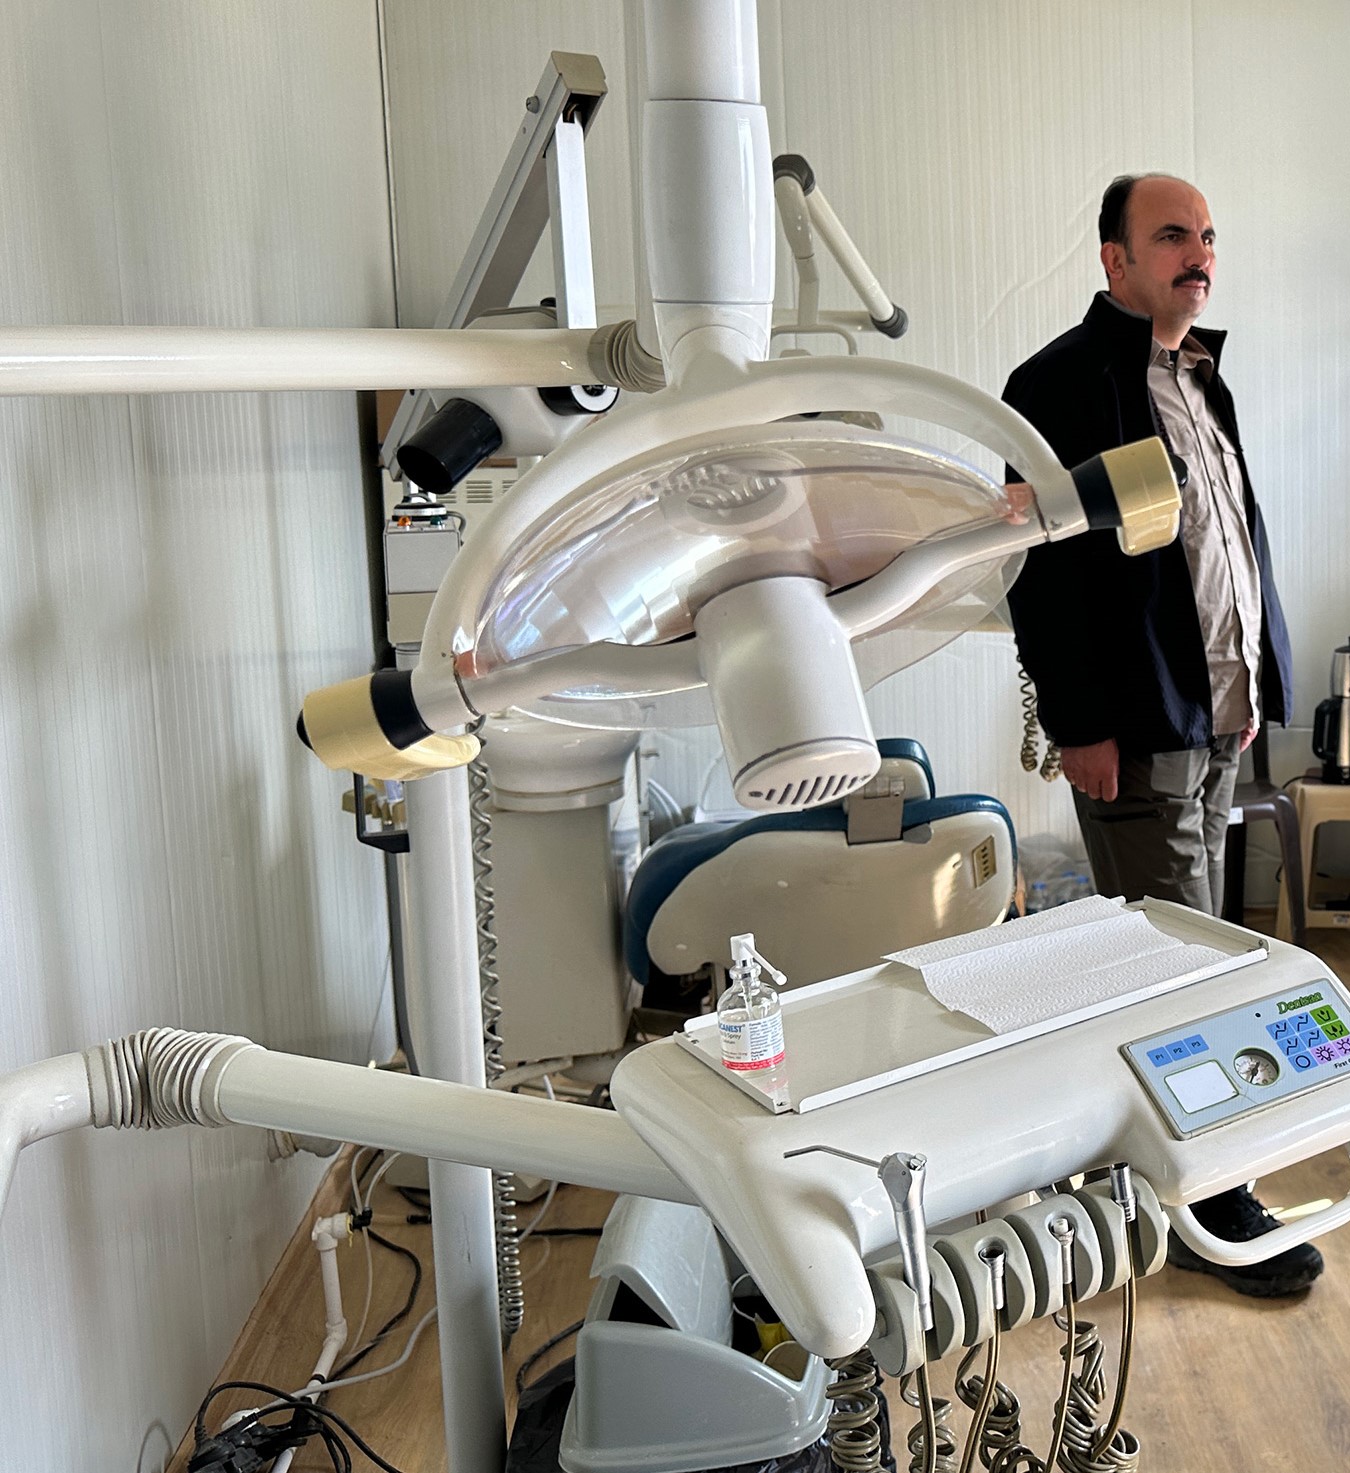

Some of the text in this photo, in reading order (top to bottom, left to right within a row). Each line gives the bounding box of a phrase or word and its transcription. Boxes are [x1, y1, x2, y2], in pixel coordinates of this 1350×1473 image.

[1191, 1040, 1202, 1048] P3
[1173, 1046, 1183, 1055] P2
[1155, 1053, 1165, 1061] P1
[1334, 1060, 1349, 1070] First
